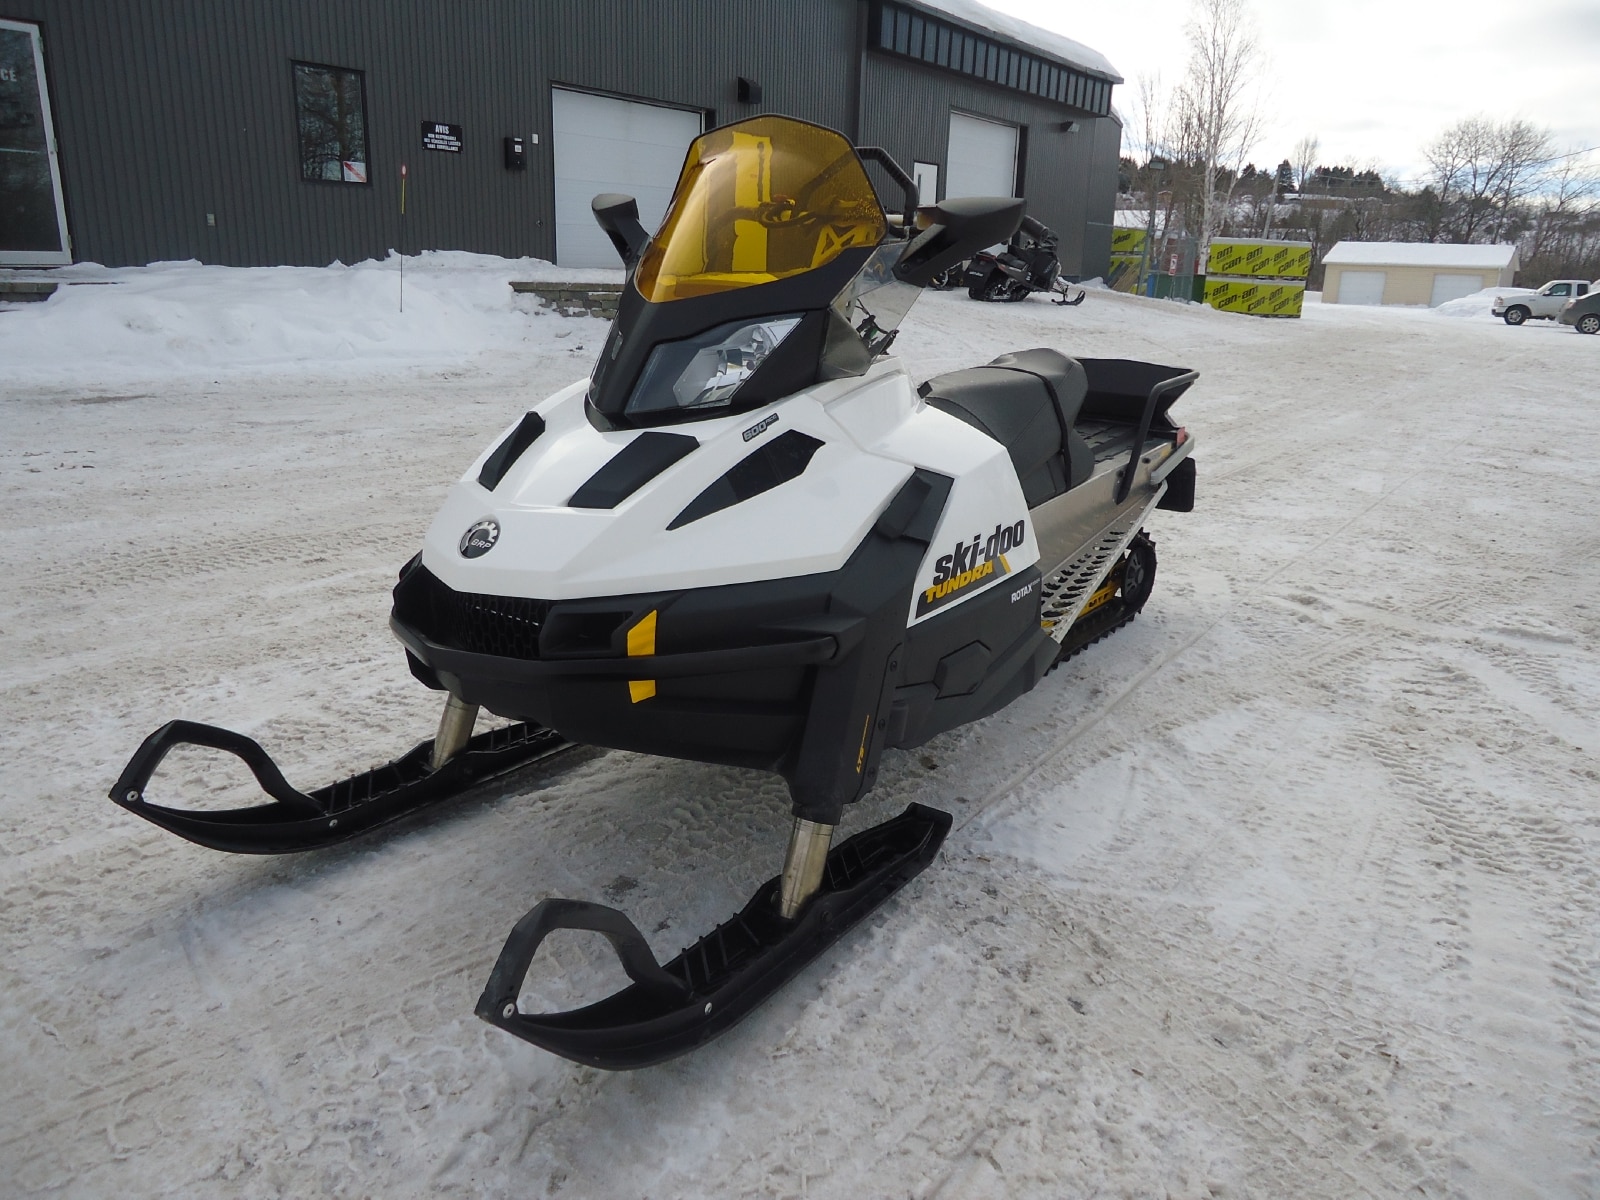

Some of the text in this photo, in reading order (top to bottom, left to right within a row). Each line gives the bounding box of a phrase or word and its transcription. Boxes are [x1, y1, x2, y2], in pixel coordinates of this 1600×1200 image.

[435, 124, 450, 134] AVIS
[932, 519, 1025, 586] ski-doo
[924, 559, 994, 604] TUNDRA
[1011, 583, 1033, 604] ROTAX
